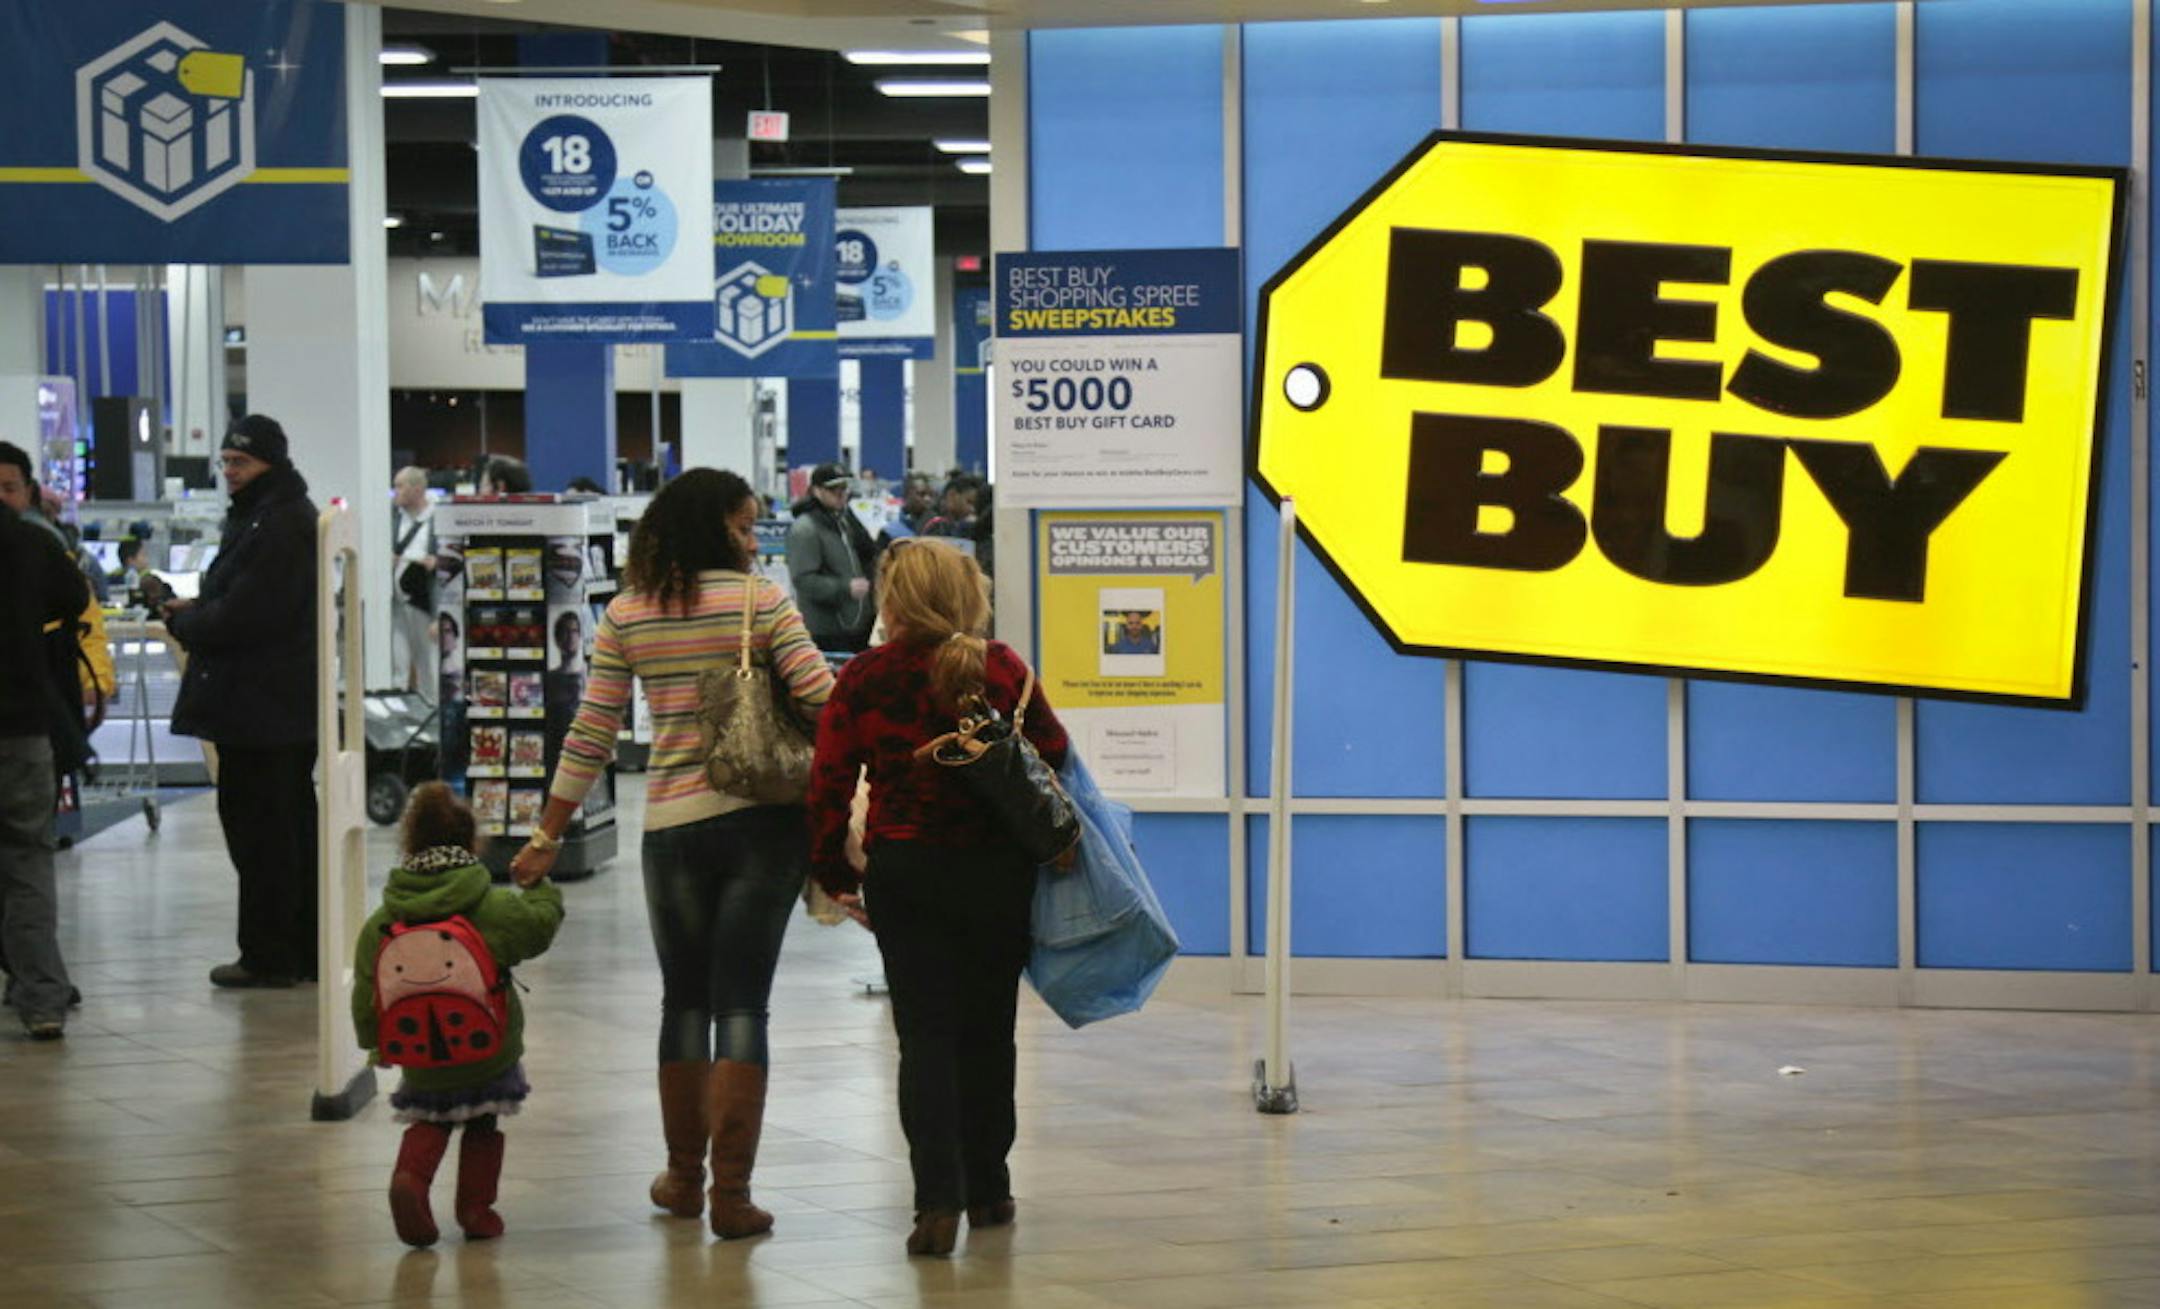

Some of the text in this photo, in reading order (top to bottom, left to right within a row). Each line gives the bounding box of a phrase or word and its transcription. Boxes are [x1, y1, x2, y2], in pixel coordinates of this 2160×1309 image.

[535, 94, 653, 107] INTRODUCING
[752, 114, 782, 138] EXIT
[541, 134, 593, 175] 18
[606, 197, 657, 232] 5%
[714, 202, 804, 214] OUR ULTIMATE
[606, 235, 658, 249] BACK
[714, 233, 806, 246] HOWROOM
[836, 240, 864, 263] 18
[1009, 266, 1112, 289] BEST BUY
[1009, 285, 1199, 309] SHOPPING SPREE
[1009, 308, 1176, 330] SWEEPSTAKES
[1379, 225, 2081, 424] BEST
[1012, 358, 1159, 372] YOU COULD WIN A
[1012, 376, 1133, 412] $5000
[1014, 415, 1175, 430] BEST BUY GIFT CARD
[1401, 410, 2011, 604] BUY
[1051, 526, 1208, 540] WE VALUE OUR
[1052, 540, 1210, 556] CUSTOMERS'
[1052, 555, 1209, 567] OPINIONS & IDEAS
